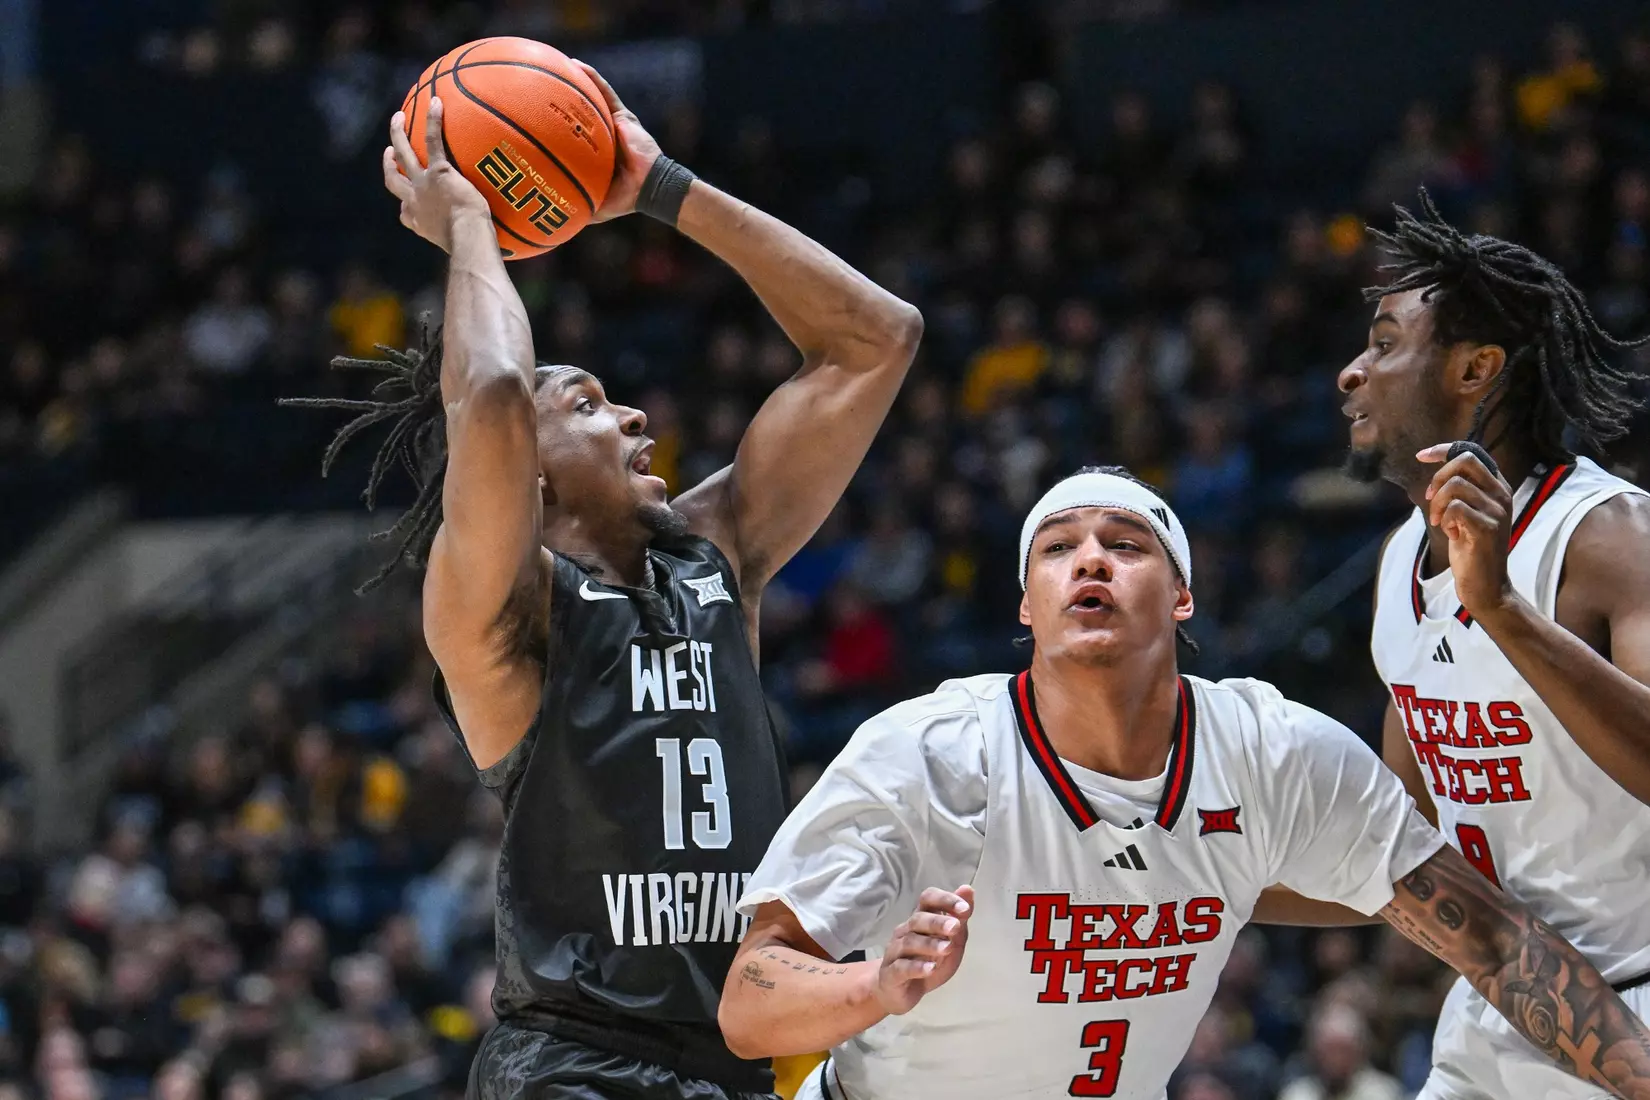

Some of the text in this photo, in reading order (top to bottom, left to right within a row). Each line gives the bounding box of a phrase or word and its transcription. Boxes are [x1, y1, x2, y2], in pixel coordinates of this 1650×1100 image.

[475, 146, 570, 237] ELITE
[500, 140, 578, 215] CHAMPIONSHIP
[631, 640, 717, 712] WEST
[1390, 682, 1533, 748] TEXAS
[655, 737, 732, 850] 13
[1415, 741, 1532, 805] TECH
[602, 872, 753, 946] VIRGINI
[1015, 893, 1225, 951] TEXAS
[1030, 950, 1198, 1004] TECH
[1067, 1018, 1131, 1098] 3
